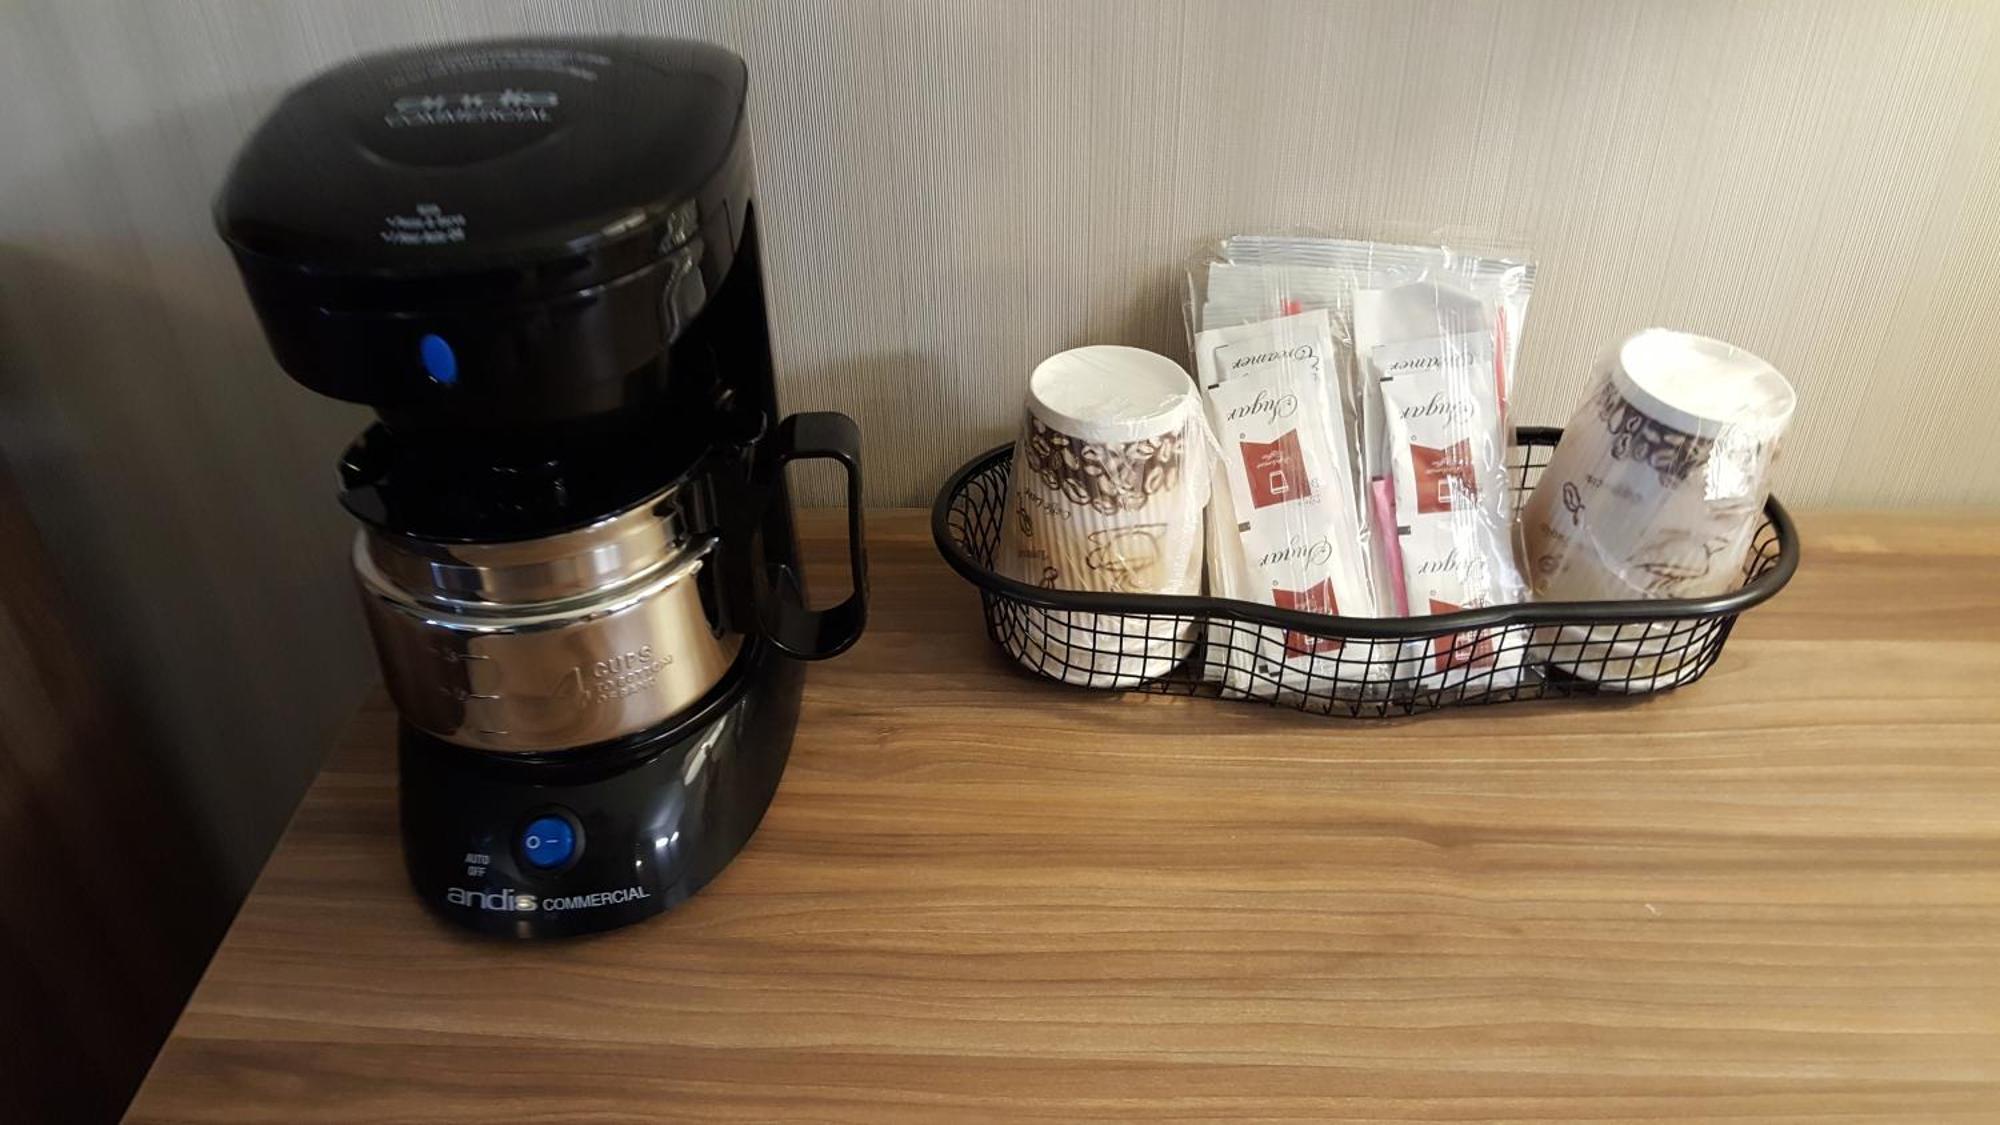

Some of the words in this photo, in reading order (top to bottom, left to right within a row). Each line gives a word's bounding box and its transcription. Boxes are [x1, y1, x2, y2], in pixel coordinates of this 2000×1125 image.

[1232, 344, 1320, 371] Creamer
[1227, 389, 1298, 425] Sugar
[1260, 534, 1333, 570] Sugar
[1418, 547, 1486, 584] gar
[594, 644, 651, 678] CUPS
[465, 852, 491, 865] AUTO
[467, 865, 487, 877] OFF
[447, 886, 538, 912] andis
[542, 885, 651, 912] COMMERCIAL
